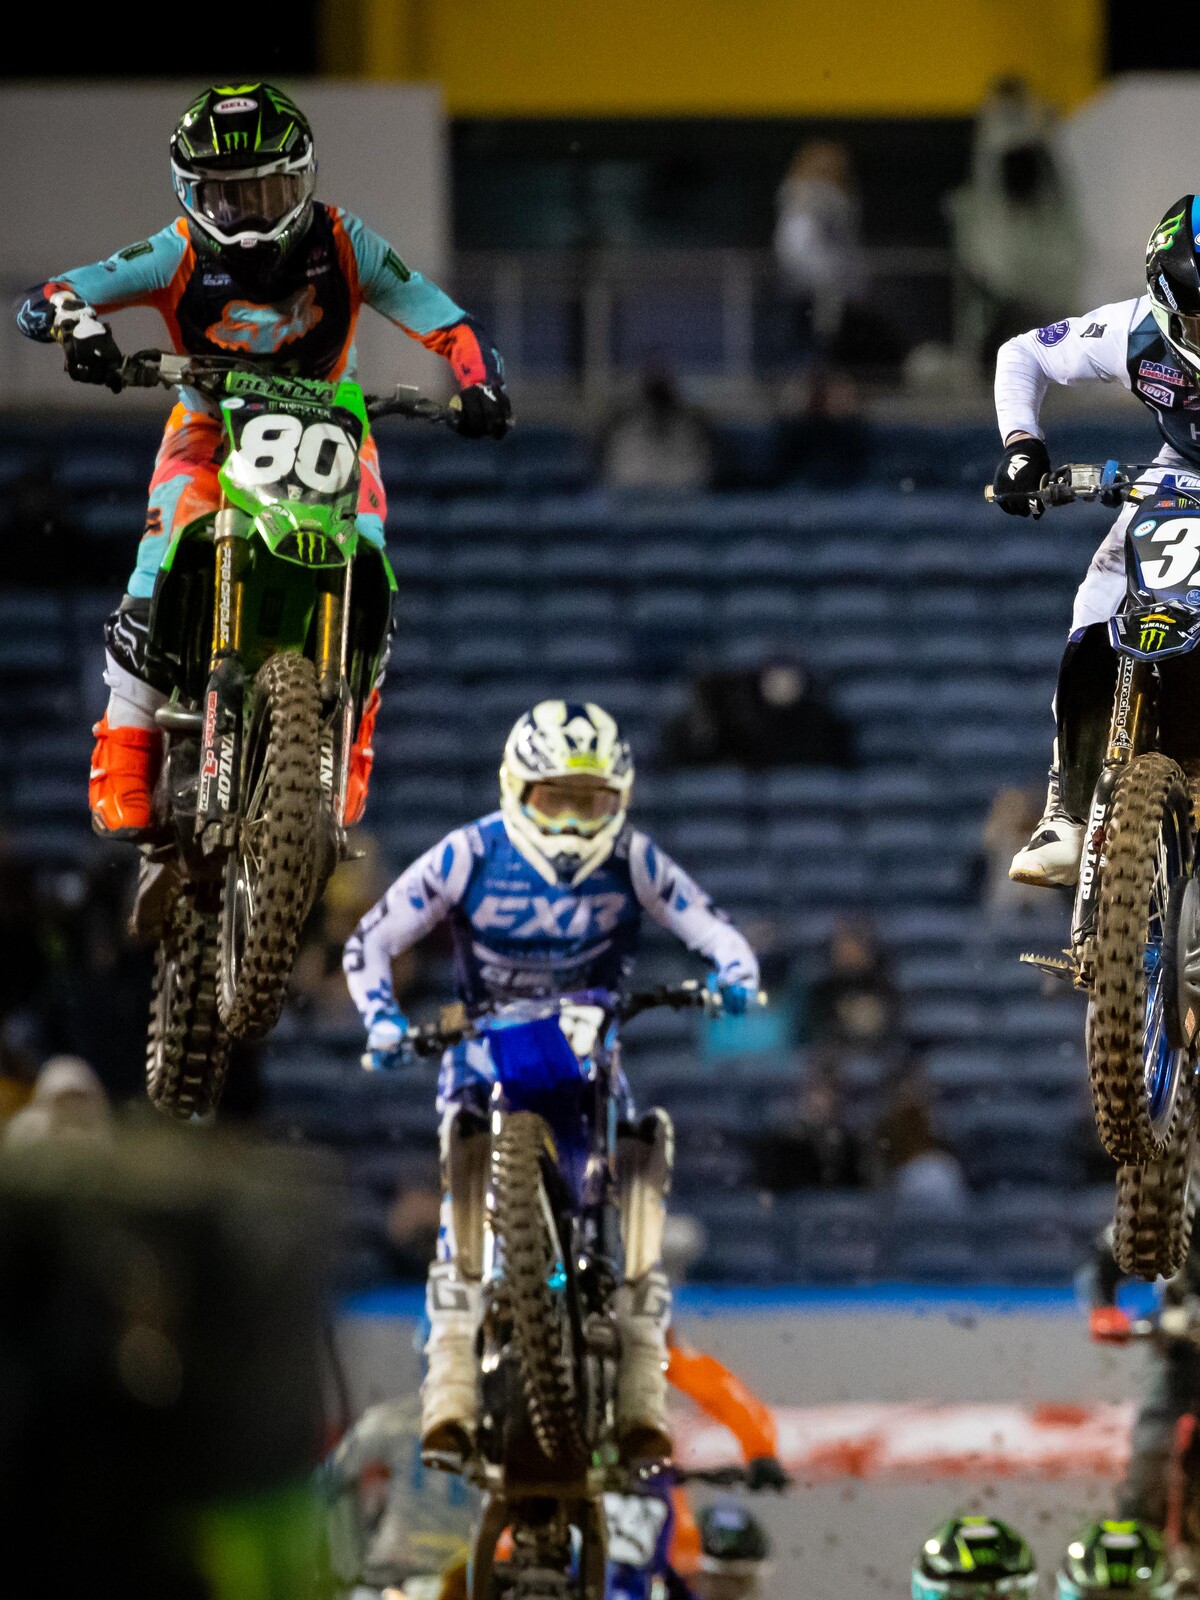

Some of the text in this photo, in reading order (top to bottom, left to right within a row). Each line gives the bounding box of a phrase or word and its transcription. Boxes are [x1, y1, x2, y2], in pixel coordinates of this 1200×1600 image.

[1140, 360, 1183, 378] PART
[1142, 383, 1169, 403] 100%
[240, 414, 357, 494] 80
[219, 547, 232, 643] PRO CIRCUIT
[1140, 622, 1170, 630] YAMAHA
[1115, 656, 1134, 728] nzoracing
